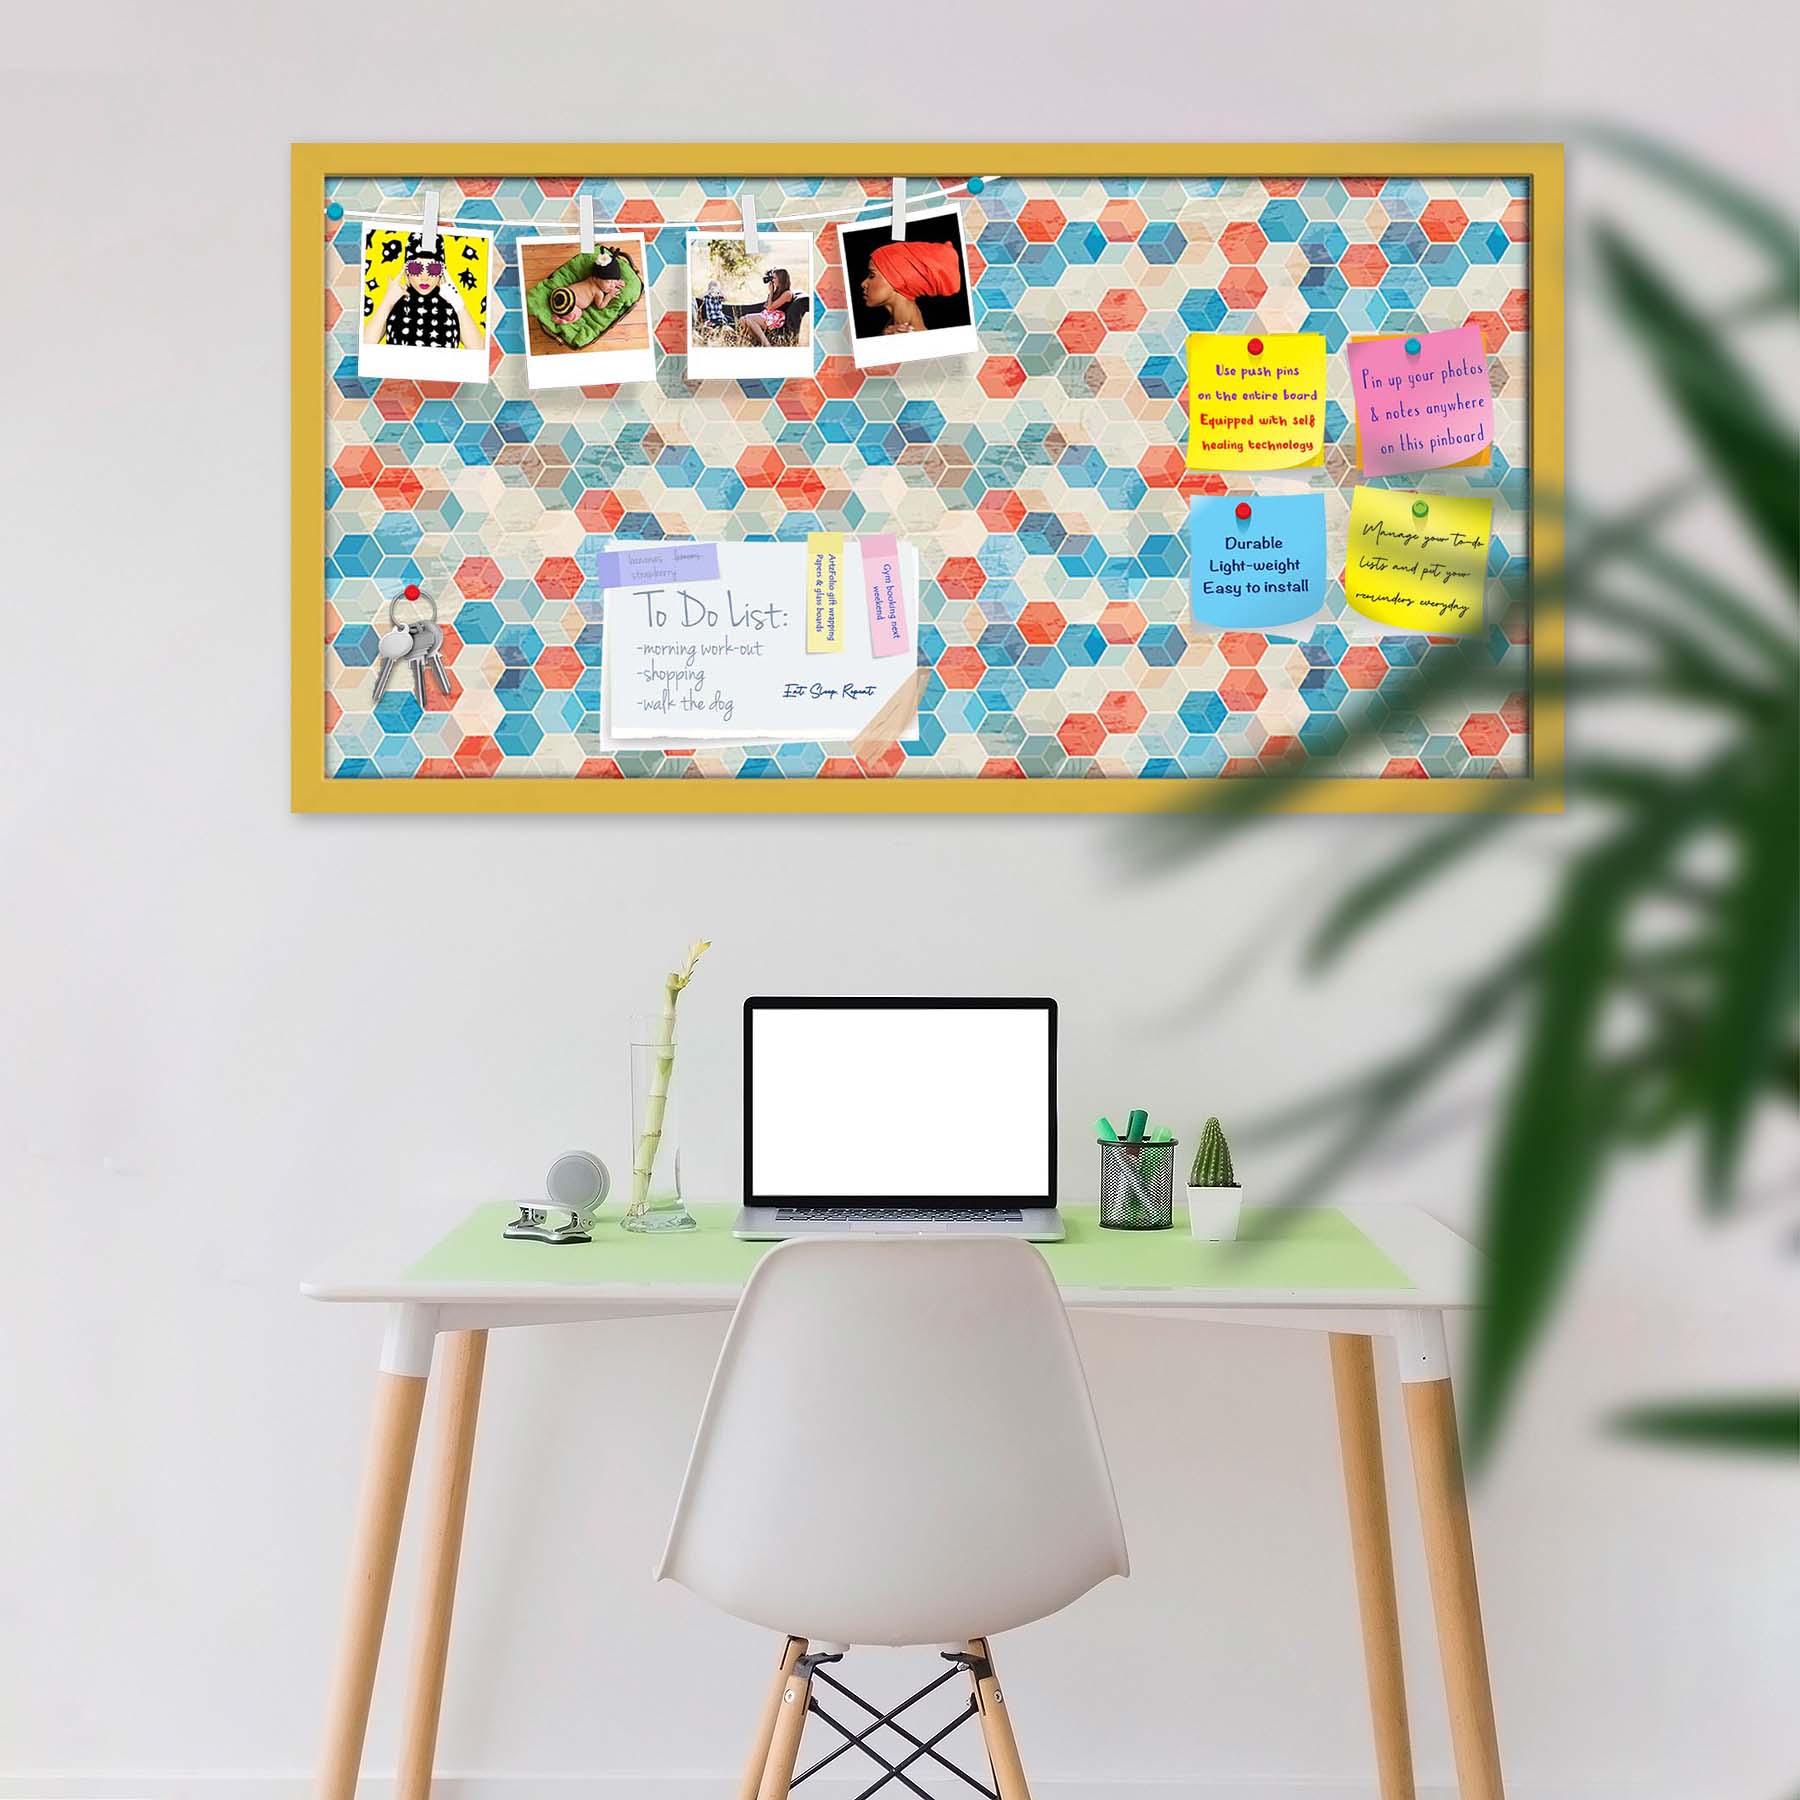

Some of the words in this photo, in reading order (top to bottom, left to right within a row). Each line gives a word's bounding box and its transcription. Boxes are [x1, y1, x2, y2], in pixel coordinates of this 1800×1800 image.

[1216, 364, 1236, 376] Use
[1241, 366, 1271, 380] push
[1277, 367, 1300, 380] pins
[1362, 368, 1382, 389] Pin
[1388, 376, 1402, 391] up
[1408, 371, 1435, 389] your
[1441, 358, 1483, 384] photos
[1198, 392, 1211, 400] on
[1216, 390, 1237, 401] the
[1242, 390, 1278, 400] entire
[1283, 389, 1318, 400] board
[1370, 406, 1379, 422] &
[1386, 400, 1420, 420] notes
[1426, 392, 1485, 418] anywhere
[1200, 413, 1254, 429] Equipped
[1259, 415, 1287, 426] with
[1293, 414, 1316, 428] self
[1202, 440, 1243, 452] healing
[1248, 440, 1314, 452] technology
[1380, 444, 1394, 455] on
[1400, 433, 1424, 452] this
[1430, 423, 1485, 453] pinboard
[1225, 536, 1283, 550] Durable
[1362, 520, 1419, 546] Manage
[1421, 534, 1449, 549] your
[814, 554, 824, 578] Papers
[828, 553, 837, 591] ArtzFolio
[882, 563, 892, 584] Gym
[1209, 558, 1301, 576] Light-weight
[1392, 561, 1419, 575] and
[1420, 563, 1447, 581] put
[1443, 571, 1471, 584] your
[814, 588, 825, 605] glass
[826, 592, 838, 606] gift
[1203, 581, 1242, 598] Easy
[1246, 582, 1261, 593] to
[1264, 579, 1309, 593] install
[632, 589, 667, 628] To
[676, 590, 718, 628] Do
[727, 589, 788, 631] List:
[873, 585, 886, 621] weekend
[885, 585, 897, 619] booking
[1355, 592, 1415, 606] reminders
[1420, 599, 1470, 618] everyday
[815, 607, 825, 632] boards
[826, 607, 835, 641] wrapping
[891, 620, 901, 639] next
[701, 634, 764, 656] work-out
[680, 688, 705, 712] the
[709, 690, 734, 722] dog
